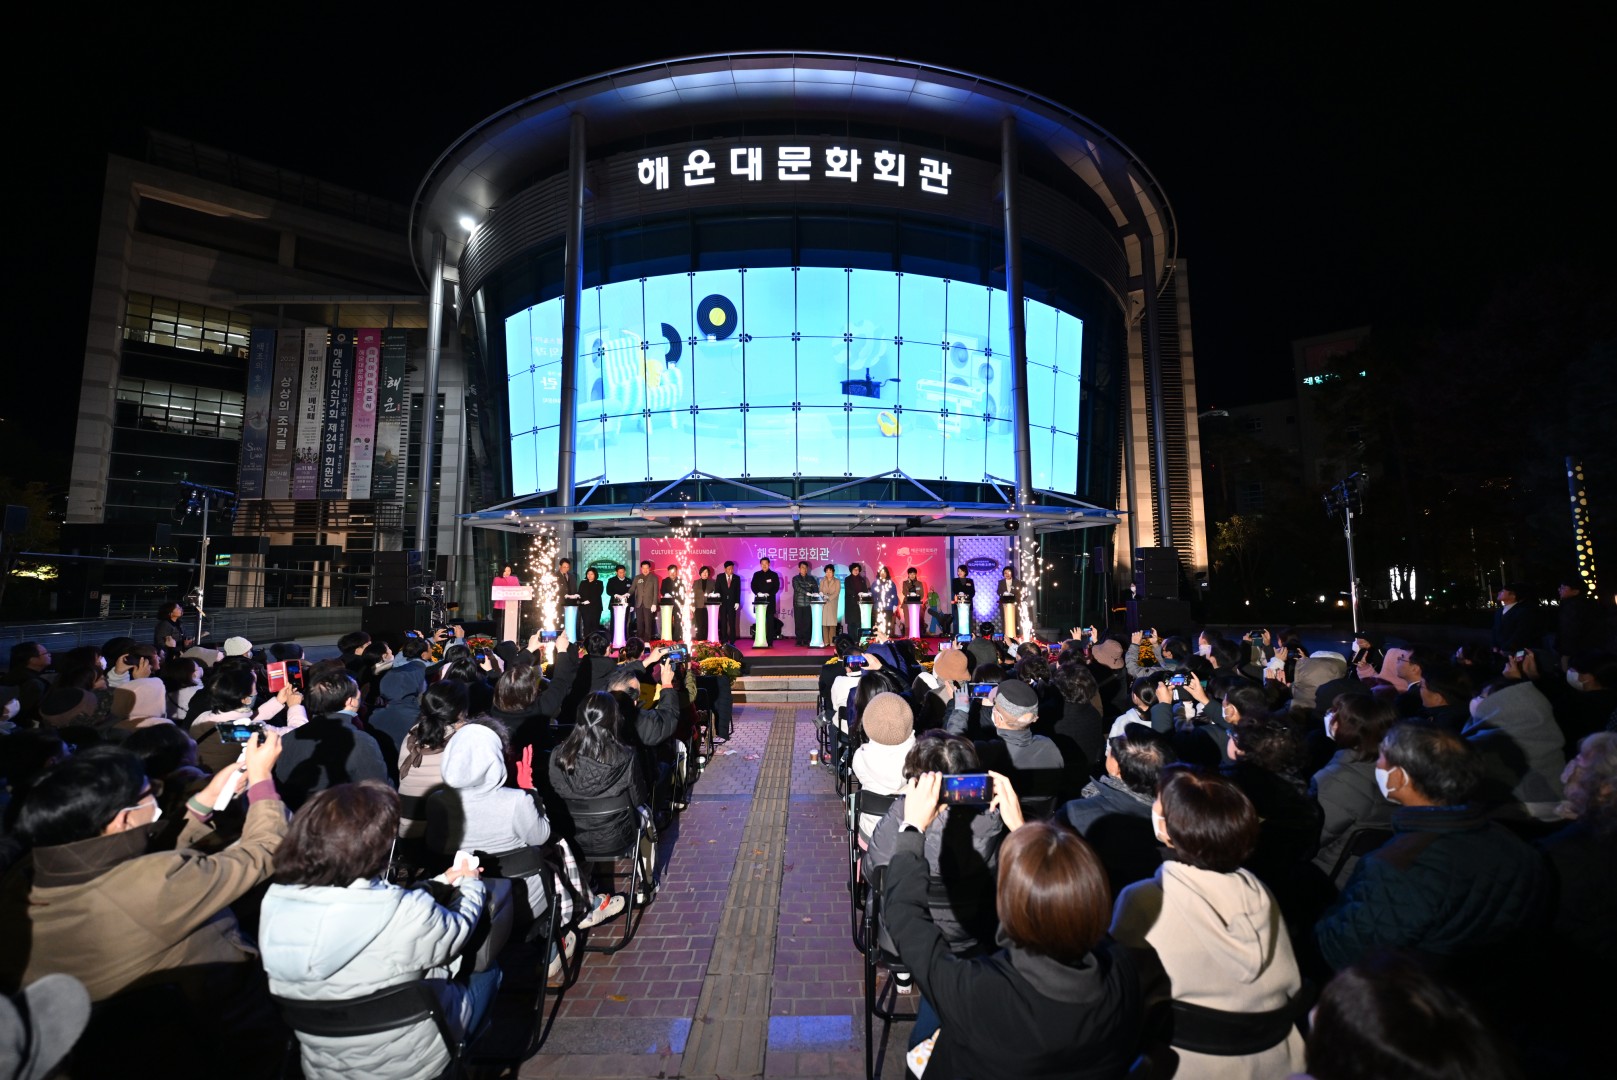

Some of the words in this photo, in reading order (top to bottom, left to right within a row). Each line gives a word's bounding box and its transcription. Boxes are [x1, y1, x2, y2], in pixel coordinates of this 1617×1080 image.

[636, 145, 952, 196] 해운대문화회관
[279, 377, 293, 411] 상상의
[275, 415, 289, 450] 조각들
[323, 456, 335, 488] 회원전
[757, 547, 830, 561] 해운대문화회관
